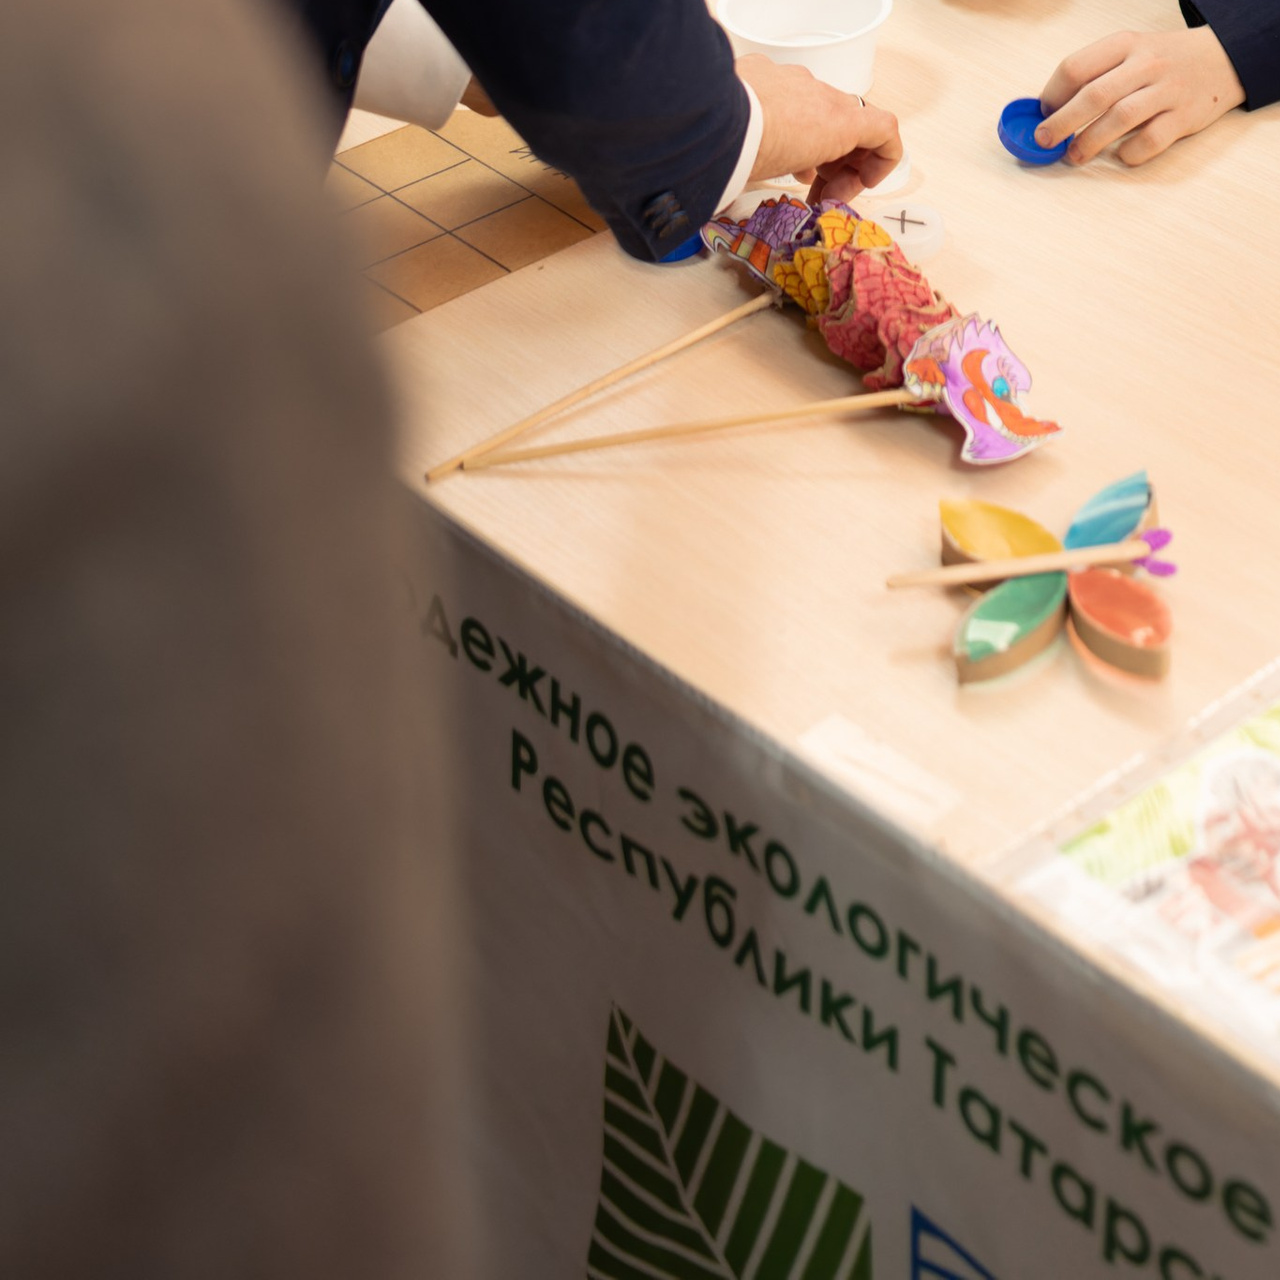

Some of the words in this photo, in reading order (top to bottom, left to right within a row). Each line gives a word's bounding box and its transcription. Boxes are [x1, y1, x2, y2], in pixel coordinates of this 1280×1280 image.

[511, 727, 899, 1073] Республики
[922, 1034, 1224, 1280] Татарс
[677, 786, 1275, 1243] экологическое
